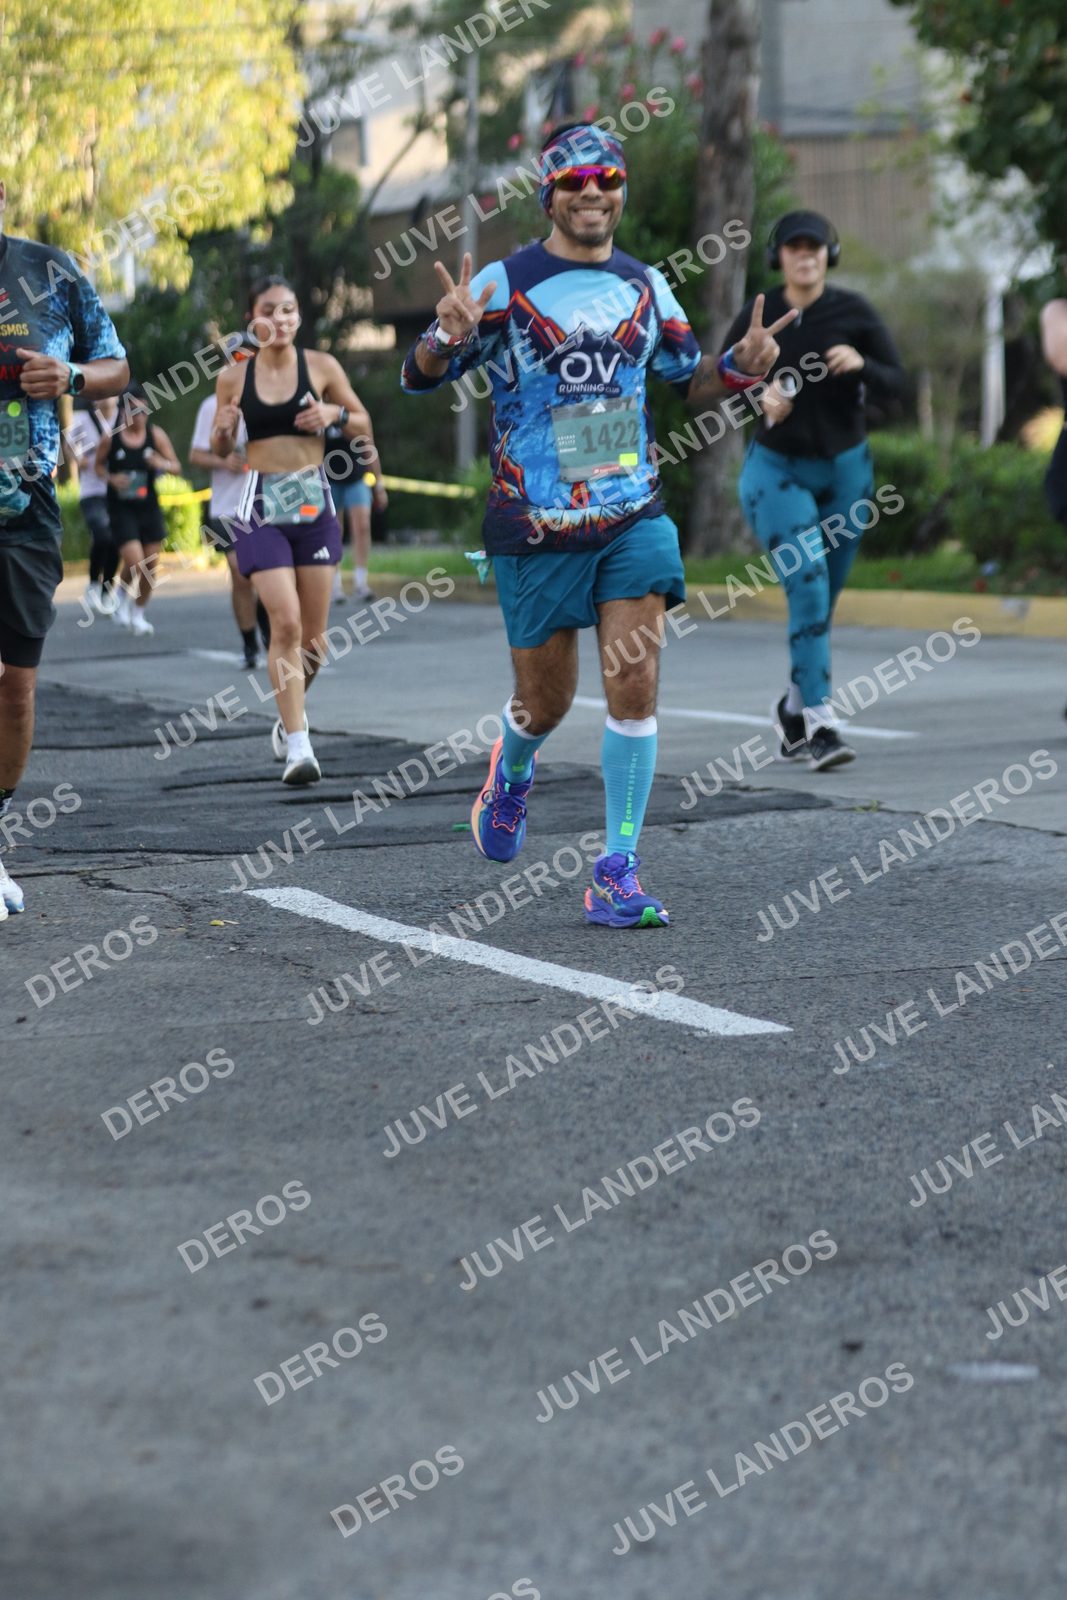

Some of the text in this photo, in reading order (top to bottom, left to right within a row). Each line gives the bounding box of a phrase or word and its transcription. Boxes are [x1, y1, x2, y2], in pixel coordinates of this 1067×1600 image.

[560, 351, 621, 383] OV
[559, 383, 605, 393] RUNNING
[581, 418, 639, 454] 1422
